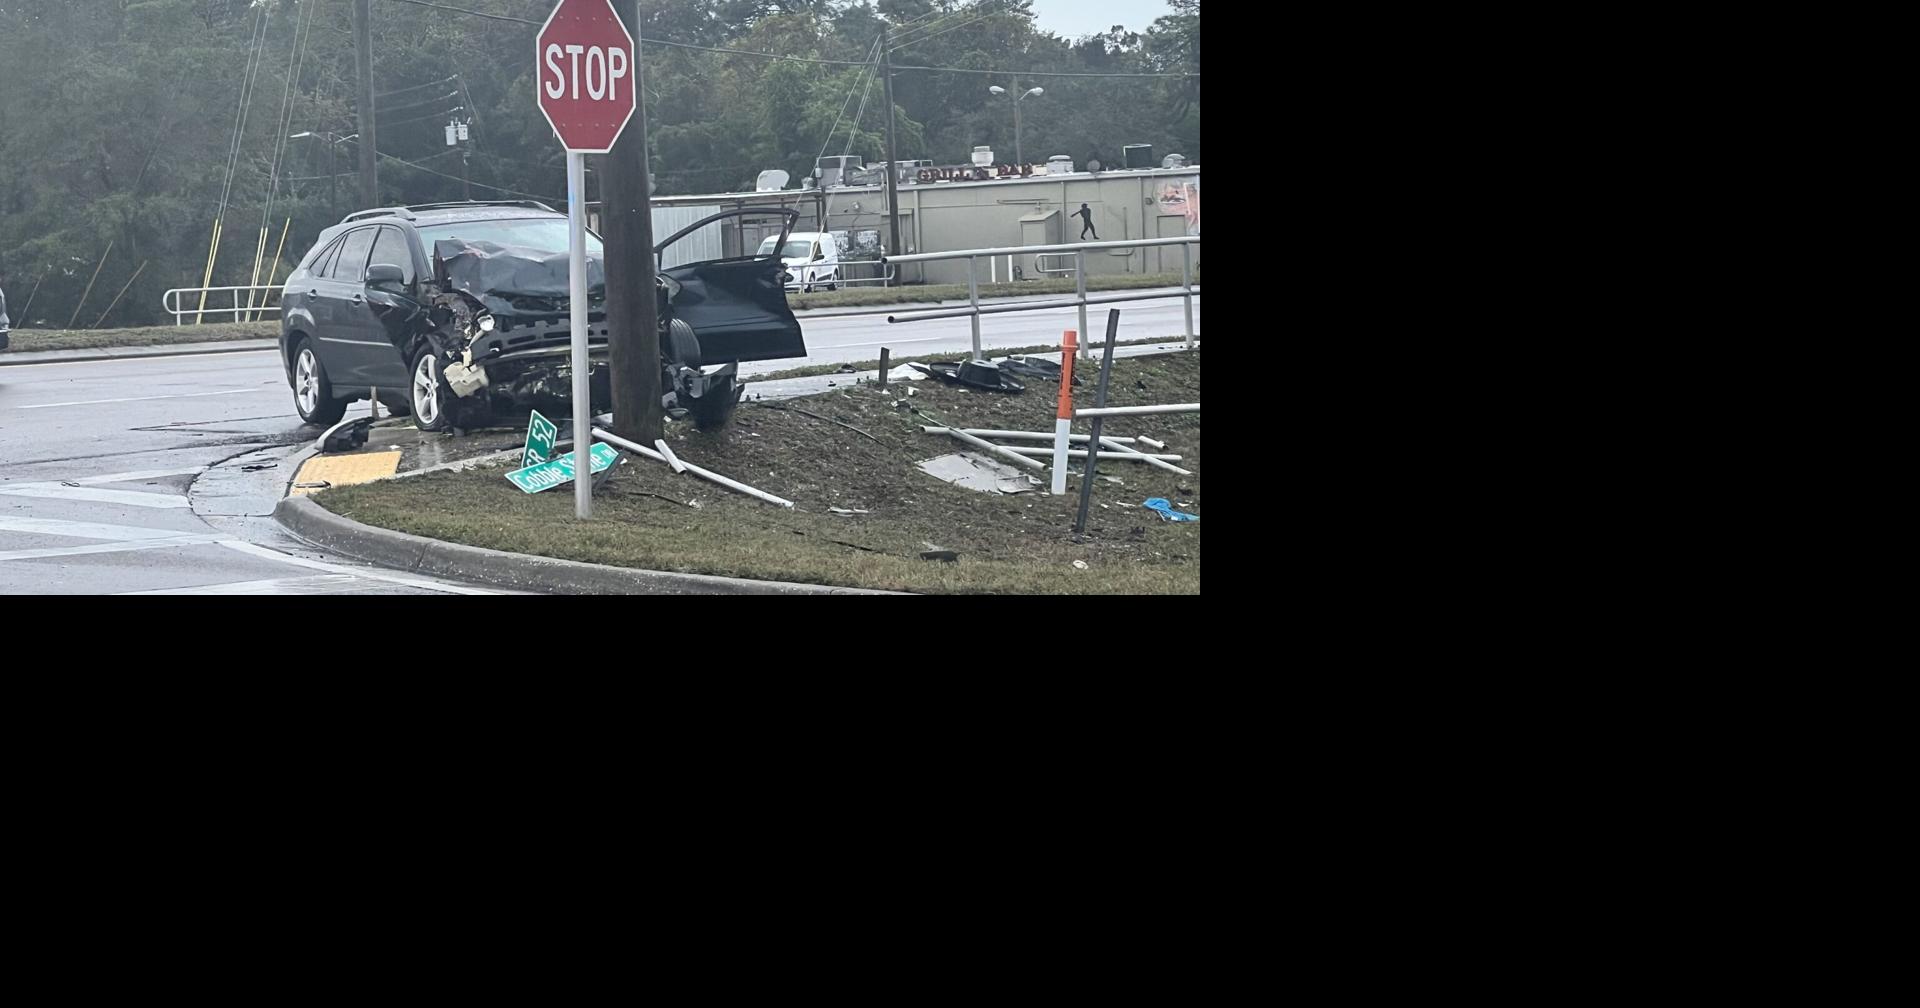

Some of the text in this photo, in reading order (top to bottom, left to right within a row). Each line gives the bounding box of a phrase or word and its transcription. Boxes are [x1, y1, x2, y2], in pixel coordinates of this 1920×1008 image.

[545, 43, 627, 101] STOP
[531, 419, 553, 449] 52
[513, 465, 565, 490] Cobble
